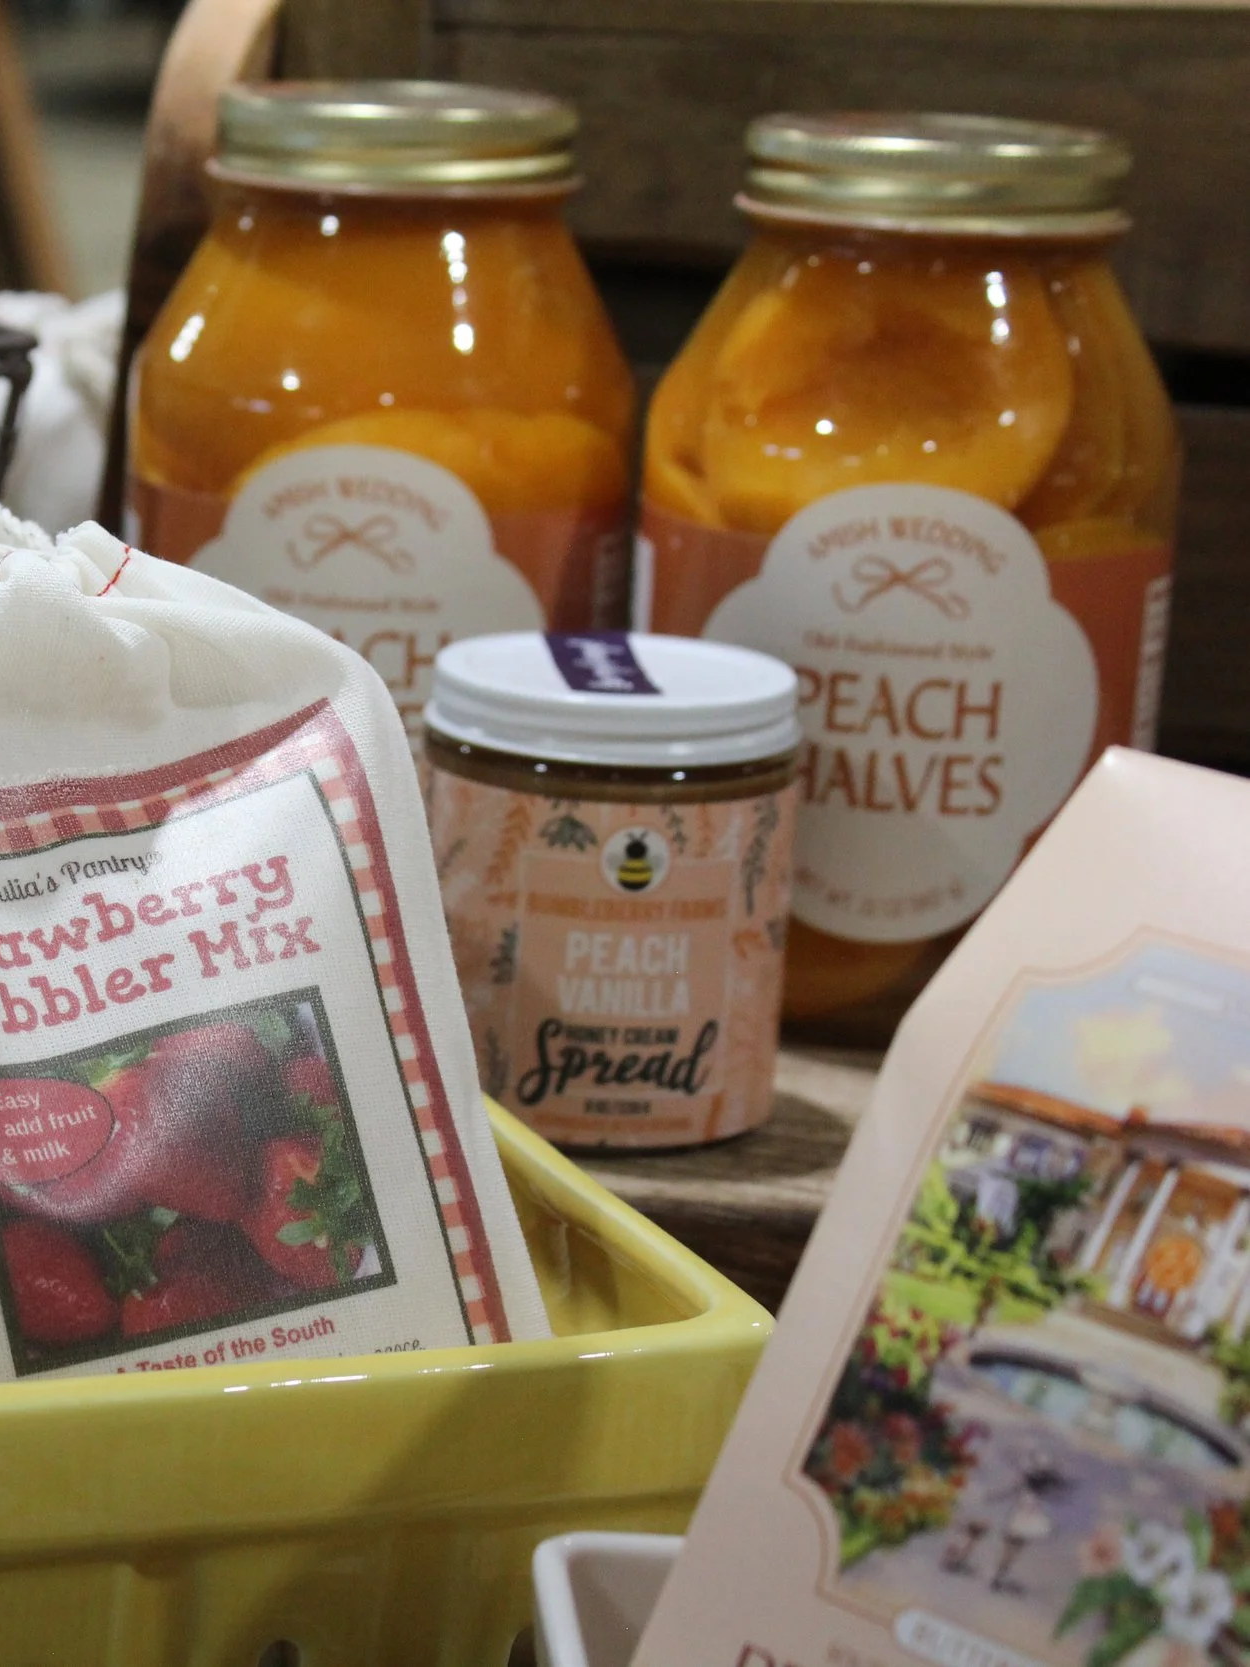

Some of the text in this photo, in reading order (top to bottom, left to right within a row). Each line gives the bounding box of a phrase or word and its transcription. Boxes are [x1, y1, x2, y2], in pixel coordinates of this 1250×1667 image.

[188, 911, 323, 979] Mix
[564, 930, 691, 975] PEACH
[556, 974, 691, 1019] VANILLA
[516, 1017, 719, 1106] Spread
[4, 1116, 44, 1137] add
[48, 1103, 98, 1131] fruit
[2, 1140, 71, 1165] & milk
[204, 1341, 226, 1365] of
[230, 1334, 267, 1358] the
[271, 1314, 336, 1349] South
